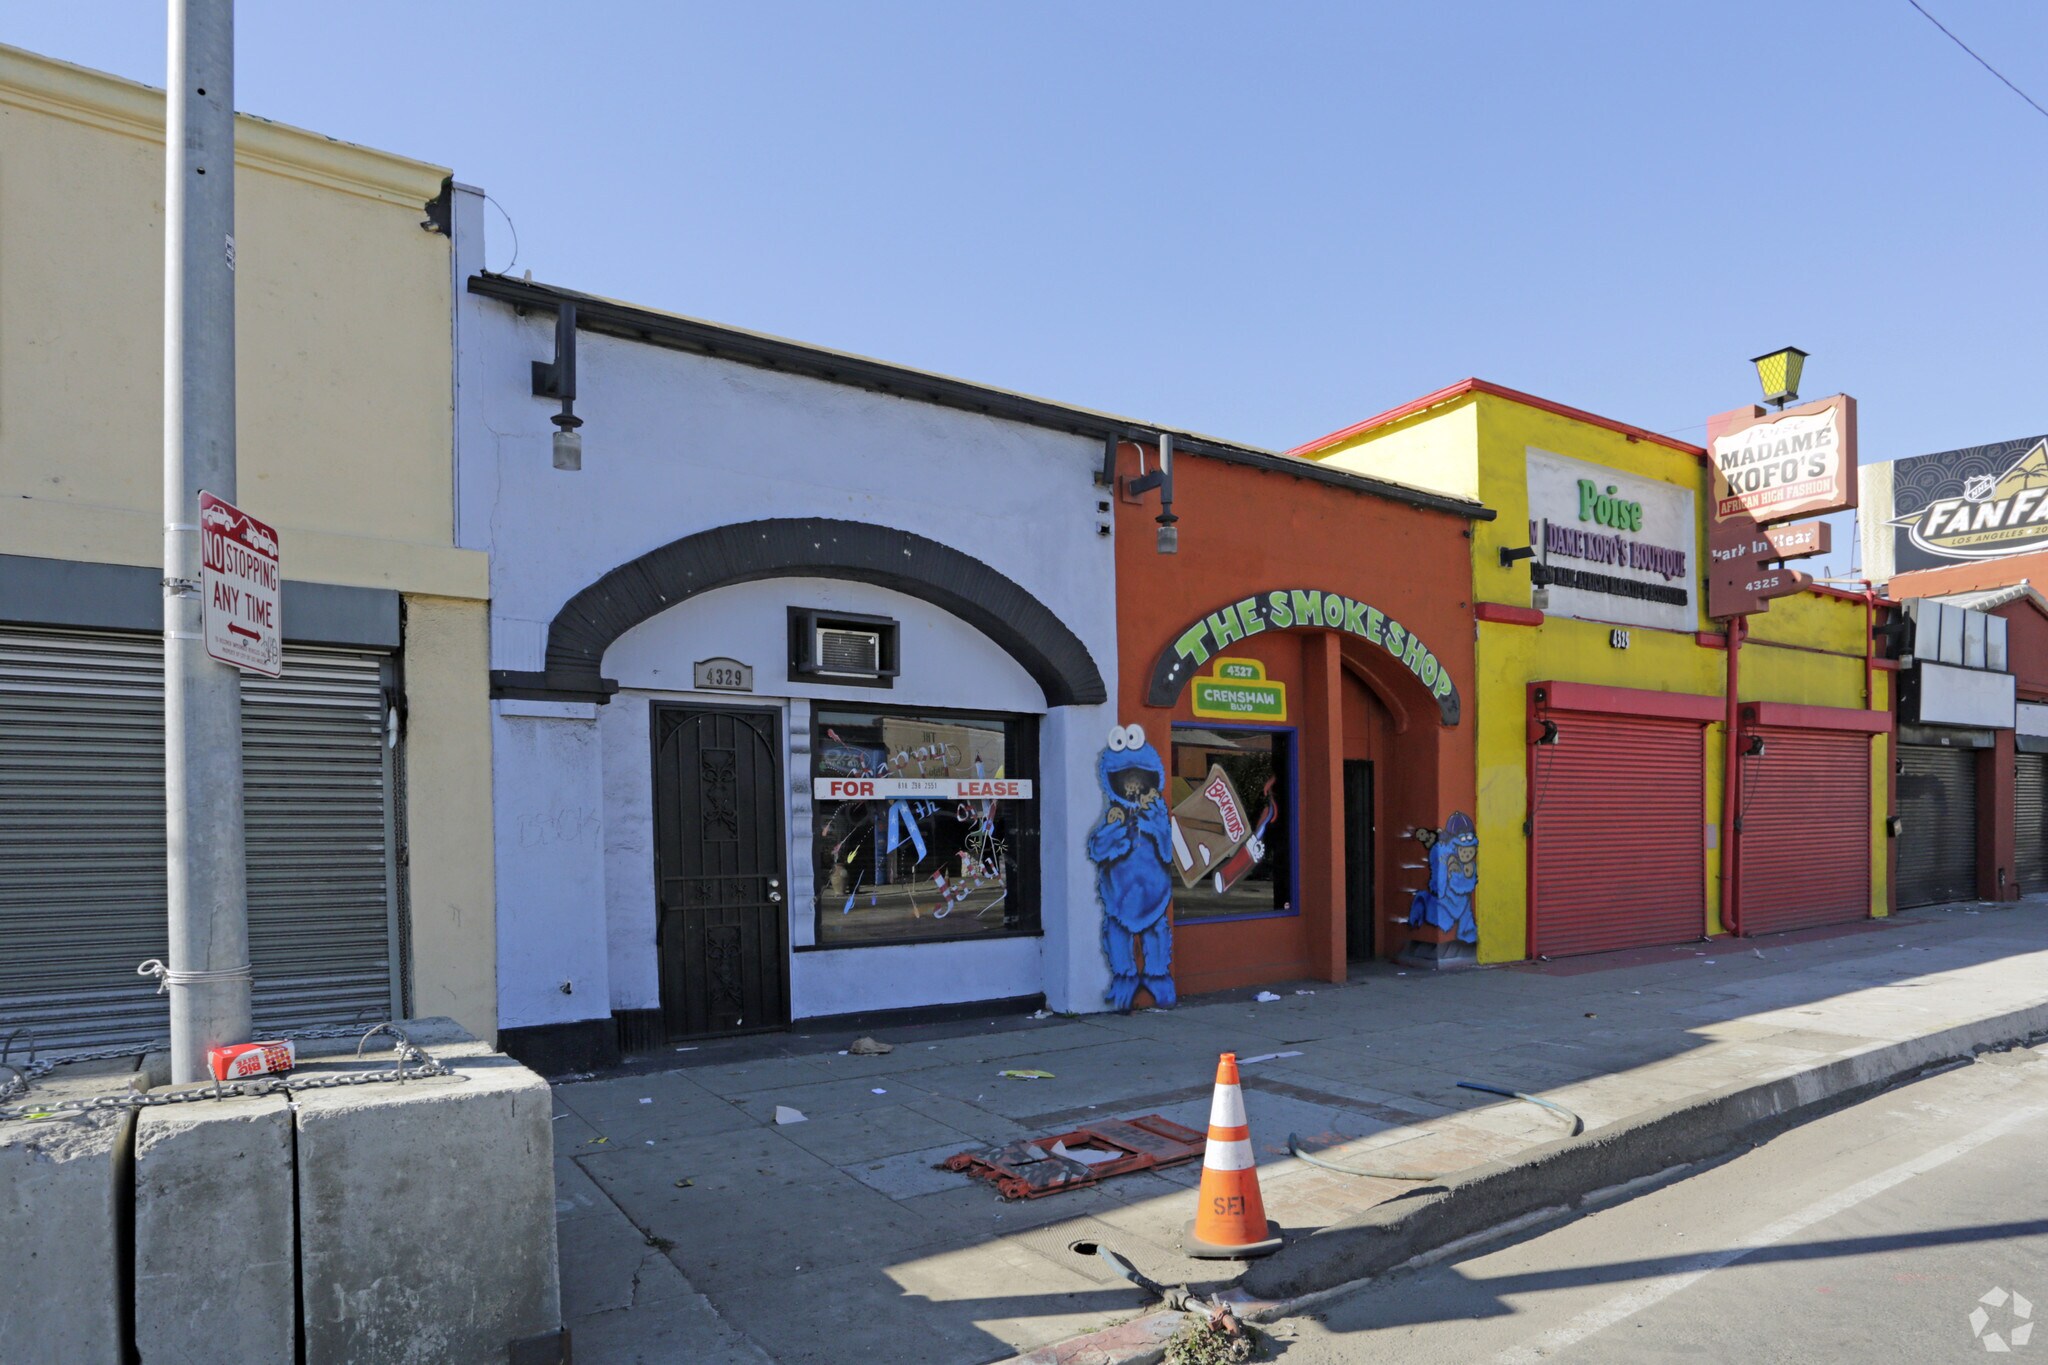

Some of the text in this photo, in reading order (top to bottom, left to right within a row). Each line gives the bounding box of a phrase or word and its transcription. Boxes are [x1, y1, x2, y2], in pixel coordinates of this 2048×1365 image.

[1720, 427, 1832, 471] MADAME
[1727, 452, 1826, 497] KOFO'S
[1721, 479, 1831, 514] AFRICAN HIGH FASHION
[1970, 480, 1991, 498] NHL
[1577, 479, 1643, 532] Poise
[1529, 519, 1687, 581] MDAME KOFO'S BOUTIQUE
[1752, 540, 1768, 554] In
[1951, 535, 1972, 546] LOS
[1975, 529, 2024, 542] ANGELES
[203, 528, 277, 592] NO STOPPING
[1745, 576, 1779, 591] 4325
[213, 580, 273, 629] ANY TIME
[1174, 590, 1452, 699] THE SMOKE SHOP
[706, 668, 742, 687] 4329
[1226, 665, 1253, 678] 4327
[1203, 688, 1275, 705] CRENSHAW
[1230, 702, 1253, 712] BLVD
[830, 781, 874, 796] FOR
[957, 782, 1019, 796] LEASE
[932, 850, 1008, 920] July
